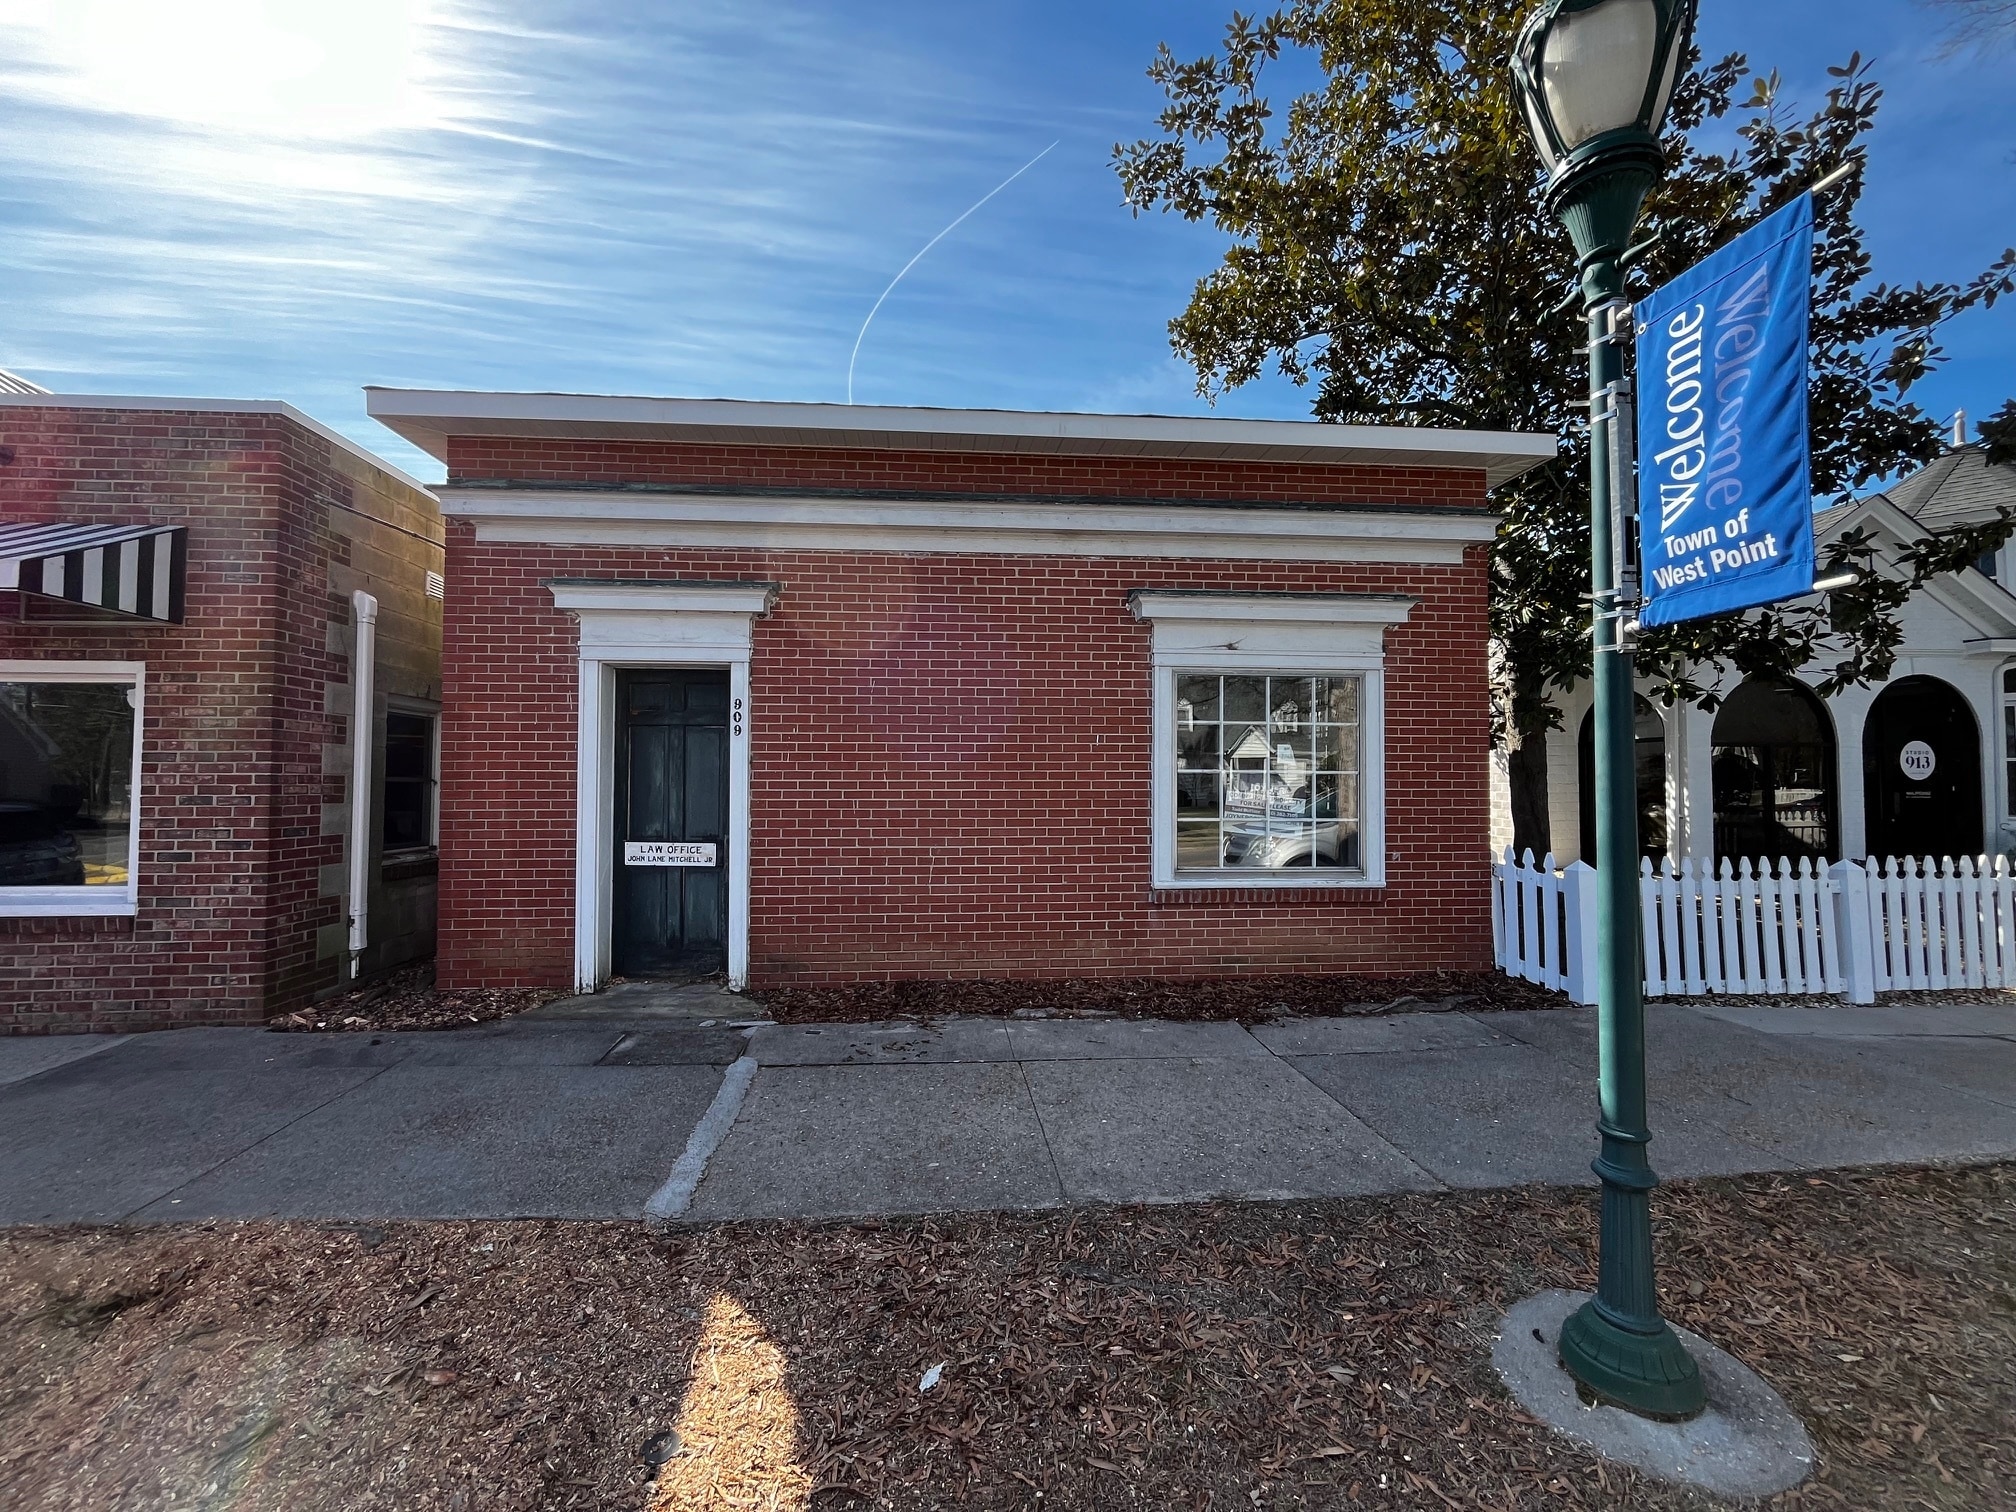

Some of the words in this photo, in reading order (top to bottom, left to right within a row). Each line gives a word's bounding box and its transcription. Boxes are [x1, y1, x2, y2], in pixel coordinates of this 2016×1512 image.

[1705, 260, 1770, 511] Welcome
[1654, 303, 1705, 534] Welcome
[1664, 526, 1717, 559] Town
[1724, 508, 1748, 538] of
[1652, 556, 1707, 590] West
[1710, 533, 1778, 573] Point
[733, 698, 742, 736] 909
[1905, 756, 1930, 769] 913
[640, 845, 663, 853] LAW
[667, 845, 702, 854] OFFICE
